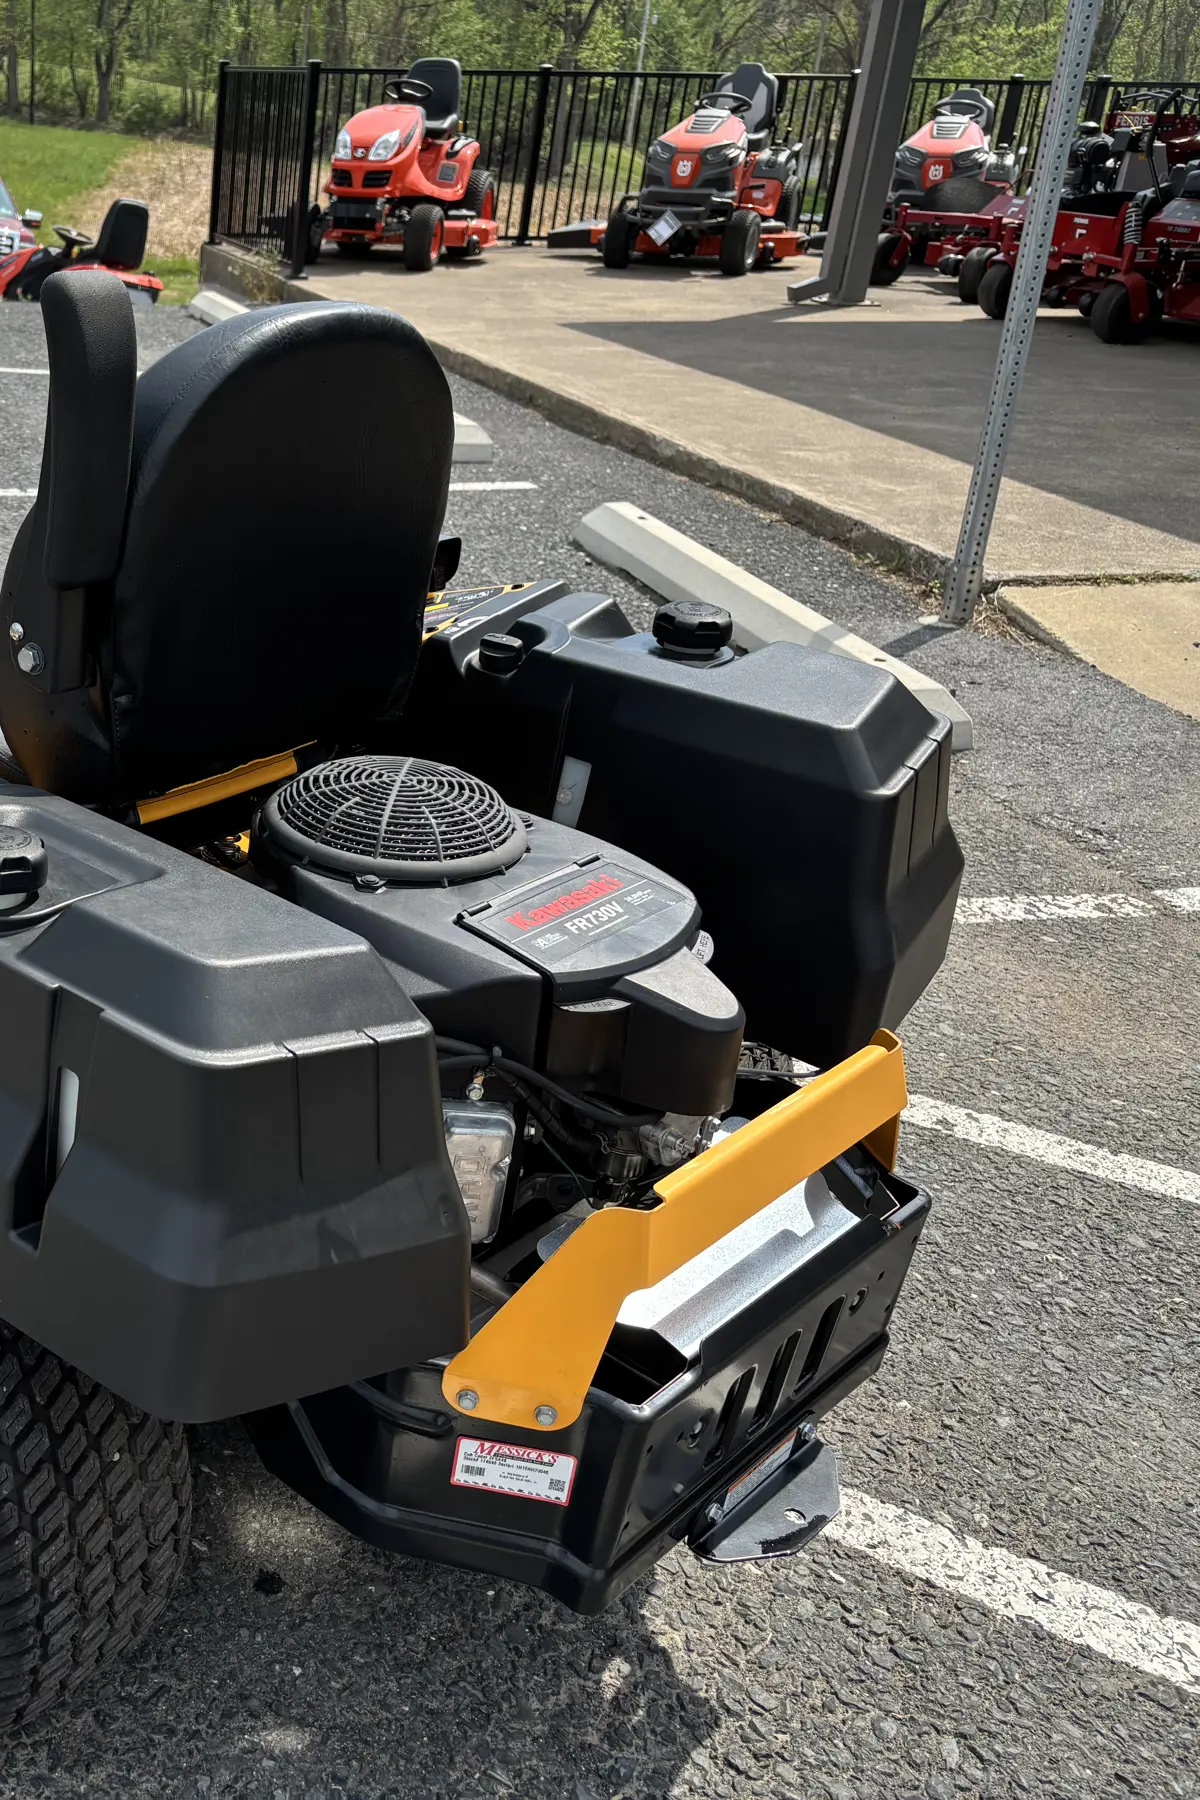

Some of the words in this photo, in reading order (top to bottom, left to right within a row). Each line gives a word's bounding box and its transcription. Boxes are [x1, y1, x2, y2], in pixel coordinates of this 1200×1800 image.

[504, 873, 625, 932] Kawasaki
[564, 901, 624, 934] FR730V
[474, 1442, 559, 1464] MESSICK'S
